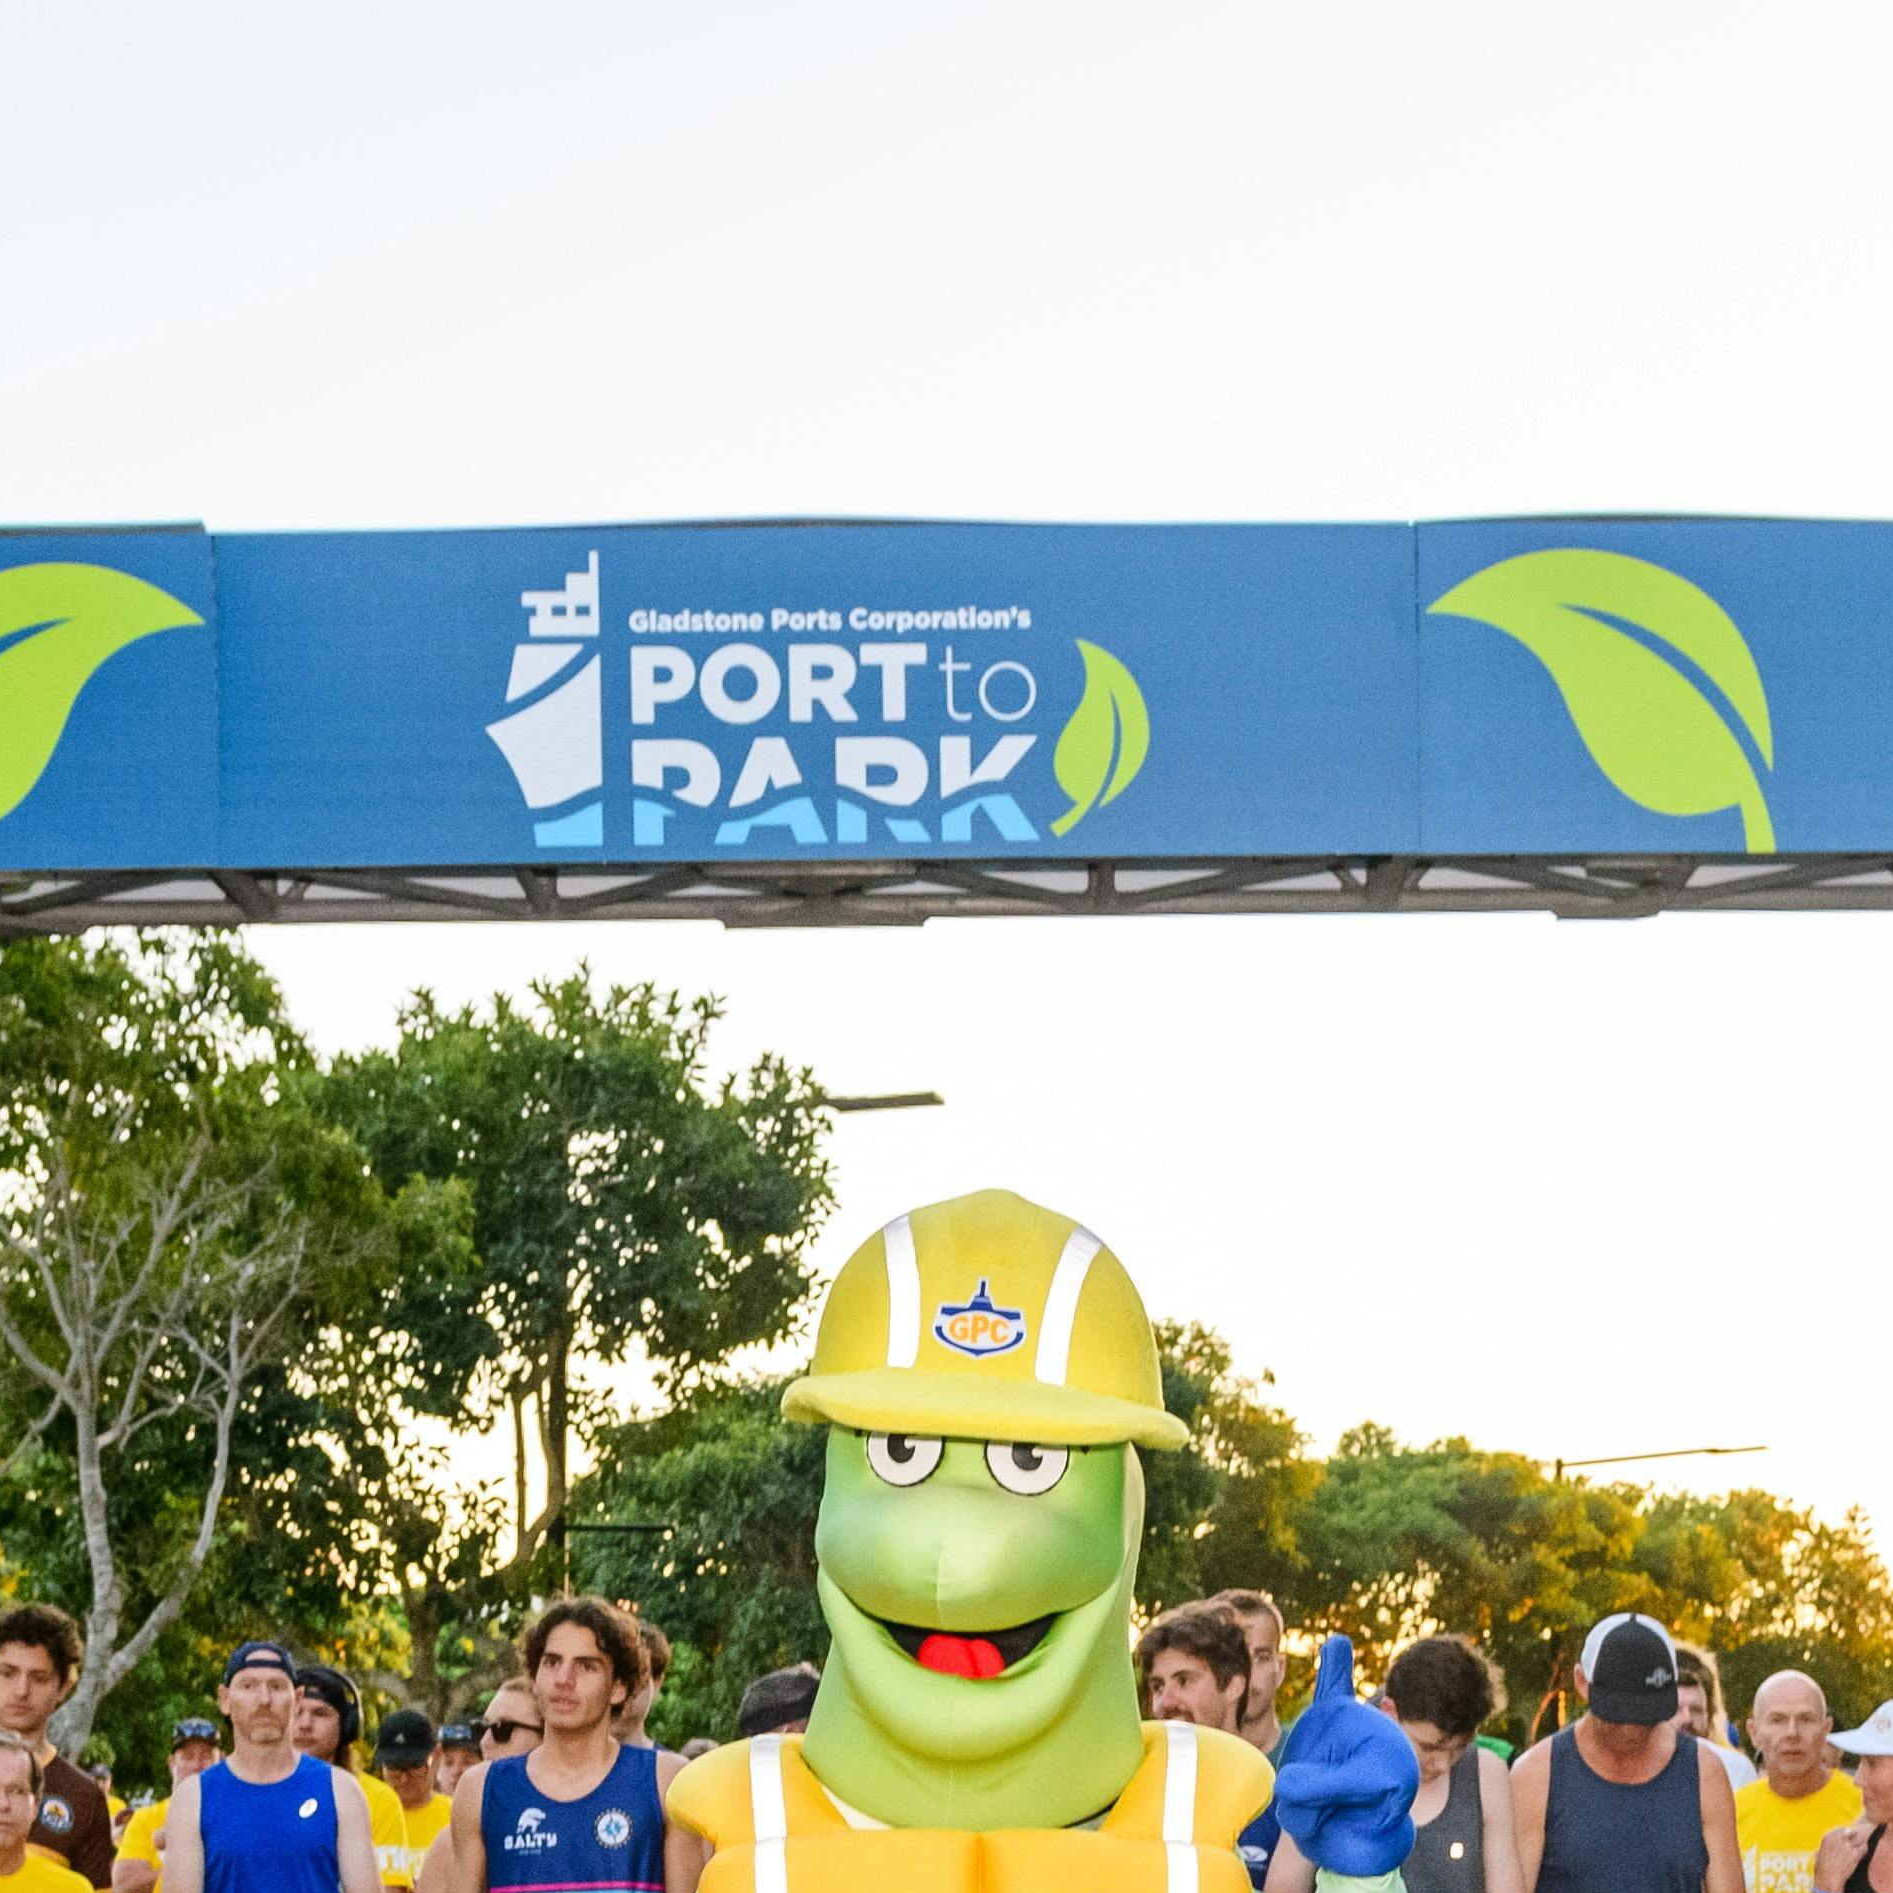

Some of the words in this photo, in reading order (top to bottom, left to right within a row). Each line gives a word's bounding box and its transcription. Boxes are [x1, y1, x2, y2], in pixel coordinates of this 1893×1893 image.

[628, 608, 764, 633] Gladstone
[771, 607, 842, 631] Ports
[848, 605, 1032, 633] Corporation's
[629, 642, 928, 725] PORT
[938, 644, 1037, 722] to
[630, 734, 1041, 846] PARK
[948, 1312, 1010, 1345] GPC
